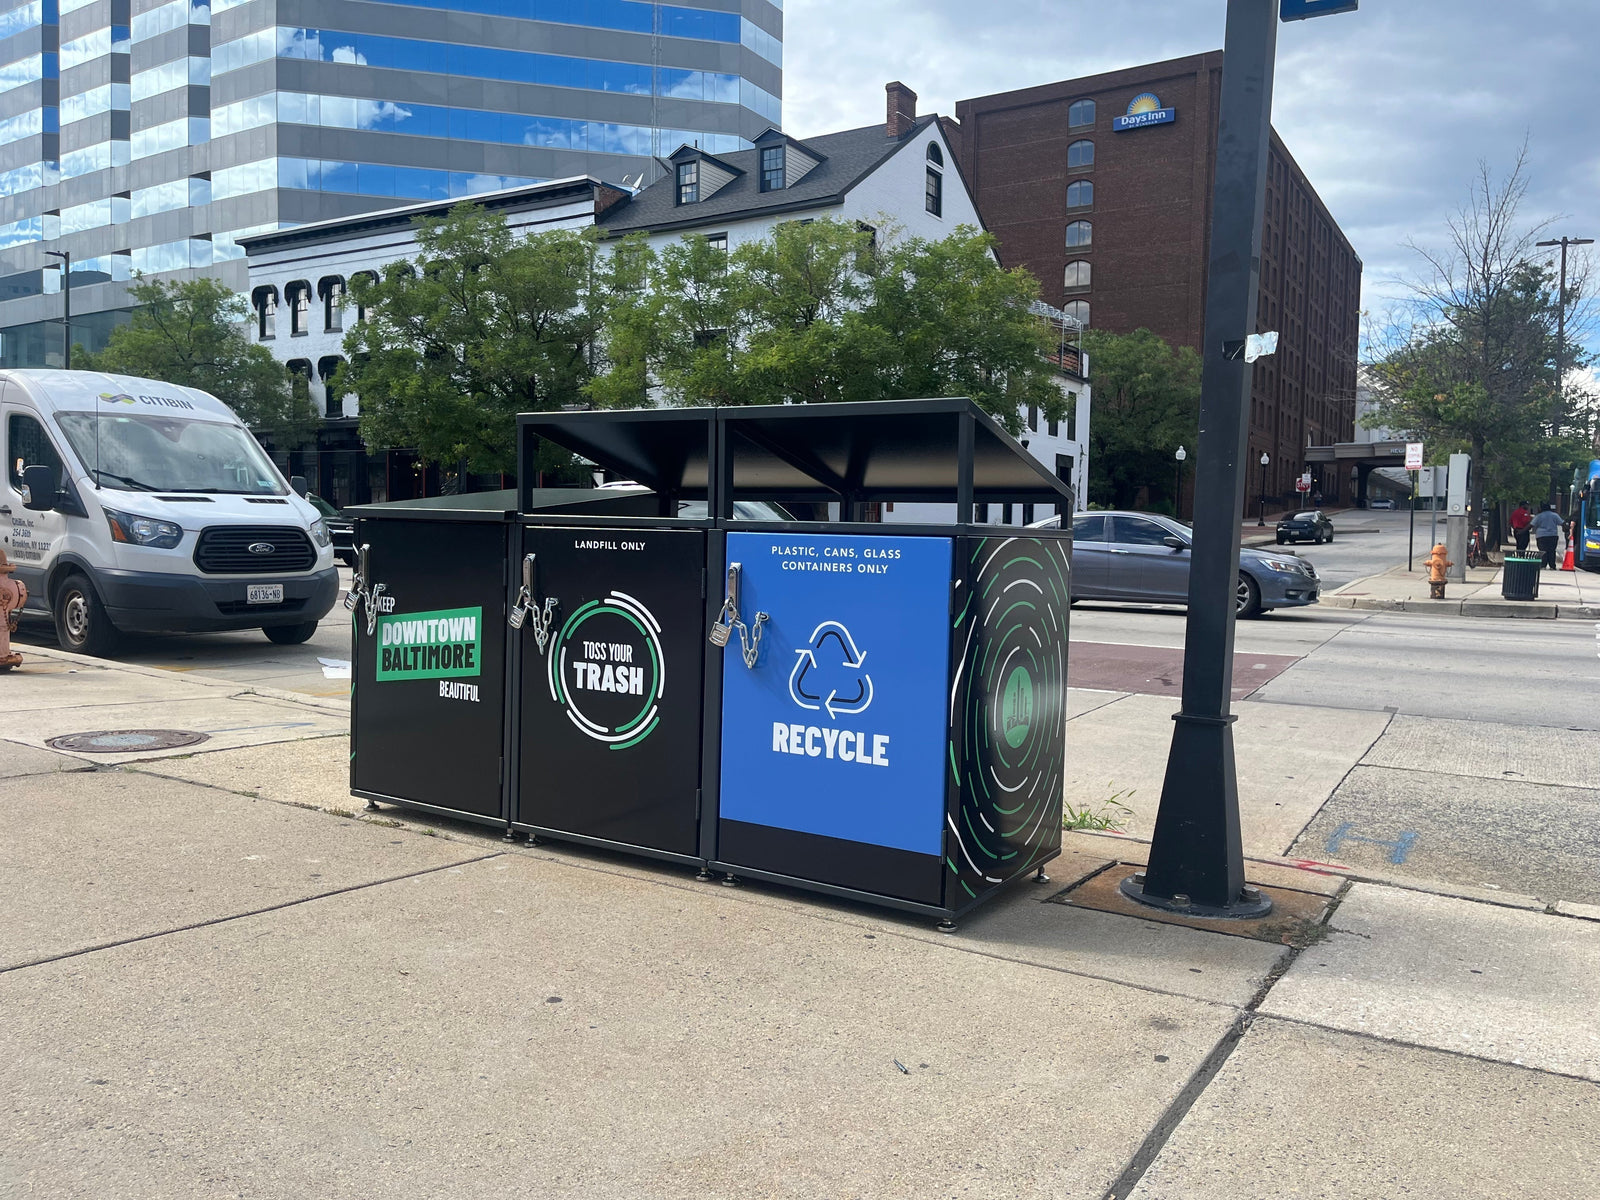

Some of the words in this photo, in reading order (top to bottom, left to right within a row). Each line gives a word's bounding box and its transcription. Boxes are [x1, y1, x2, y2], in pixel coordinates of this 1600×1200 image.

[1121, 114, 1147, 125] Days
[1148, 111, 1166, 120] Inn
[139, 395, 194, 410] CITIBIN
[31, 541, 37, 549] NY
[575, 540, 618, 550] LANDFILL
[621, 541, 646, 551] ONLY
[771, 546, 819, 557] PLASTIC,
[824, 547, 858, 559] CANS,
[863, 548, 901, 559] GLASS
[782, 561, 853, 573] CONTAINERS
[857, 563, 889, 574] ONLY
[378, 596, 396, 613] KEEP
[382, 616, 476, 645] DOWNTOWN
[382, 643, 475, 672] BALTIMORE
[583, 641, 607, 661] TOSS
[608, 643, 633, 663] YOUR
[573, 661, 644, 696] TRASH
[439, 680, 480, 702] BEAUTIFUL
[772, 721, 890, 767] RECYCLE
